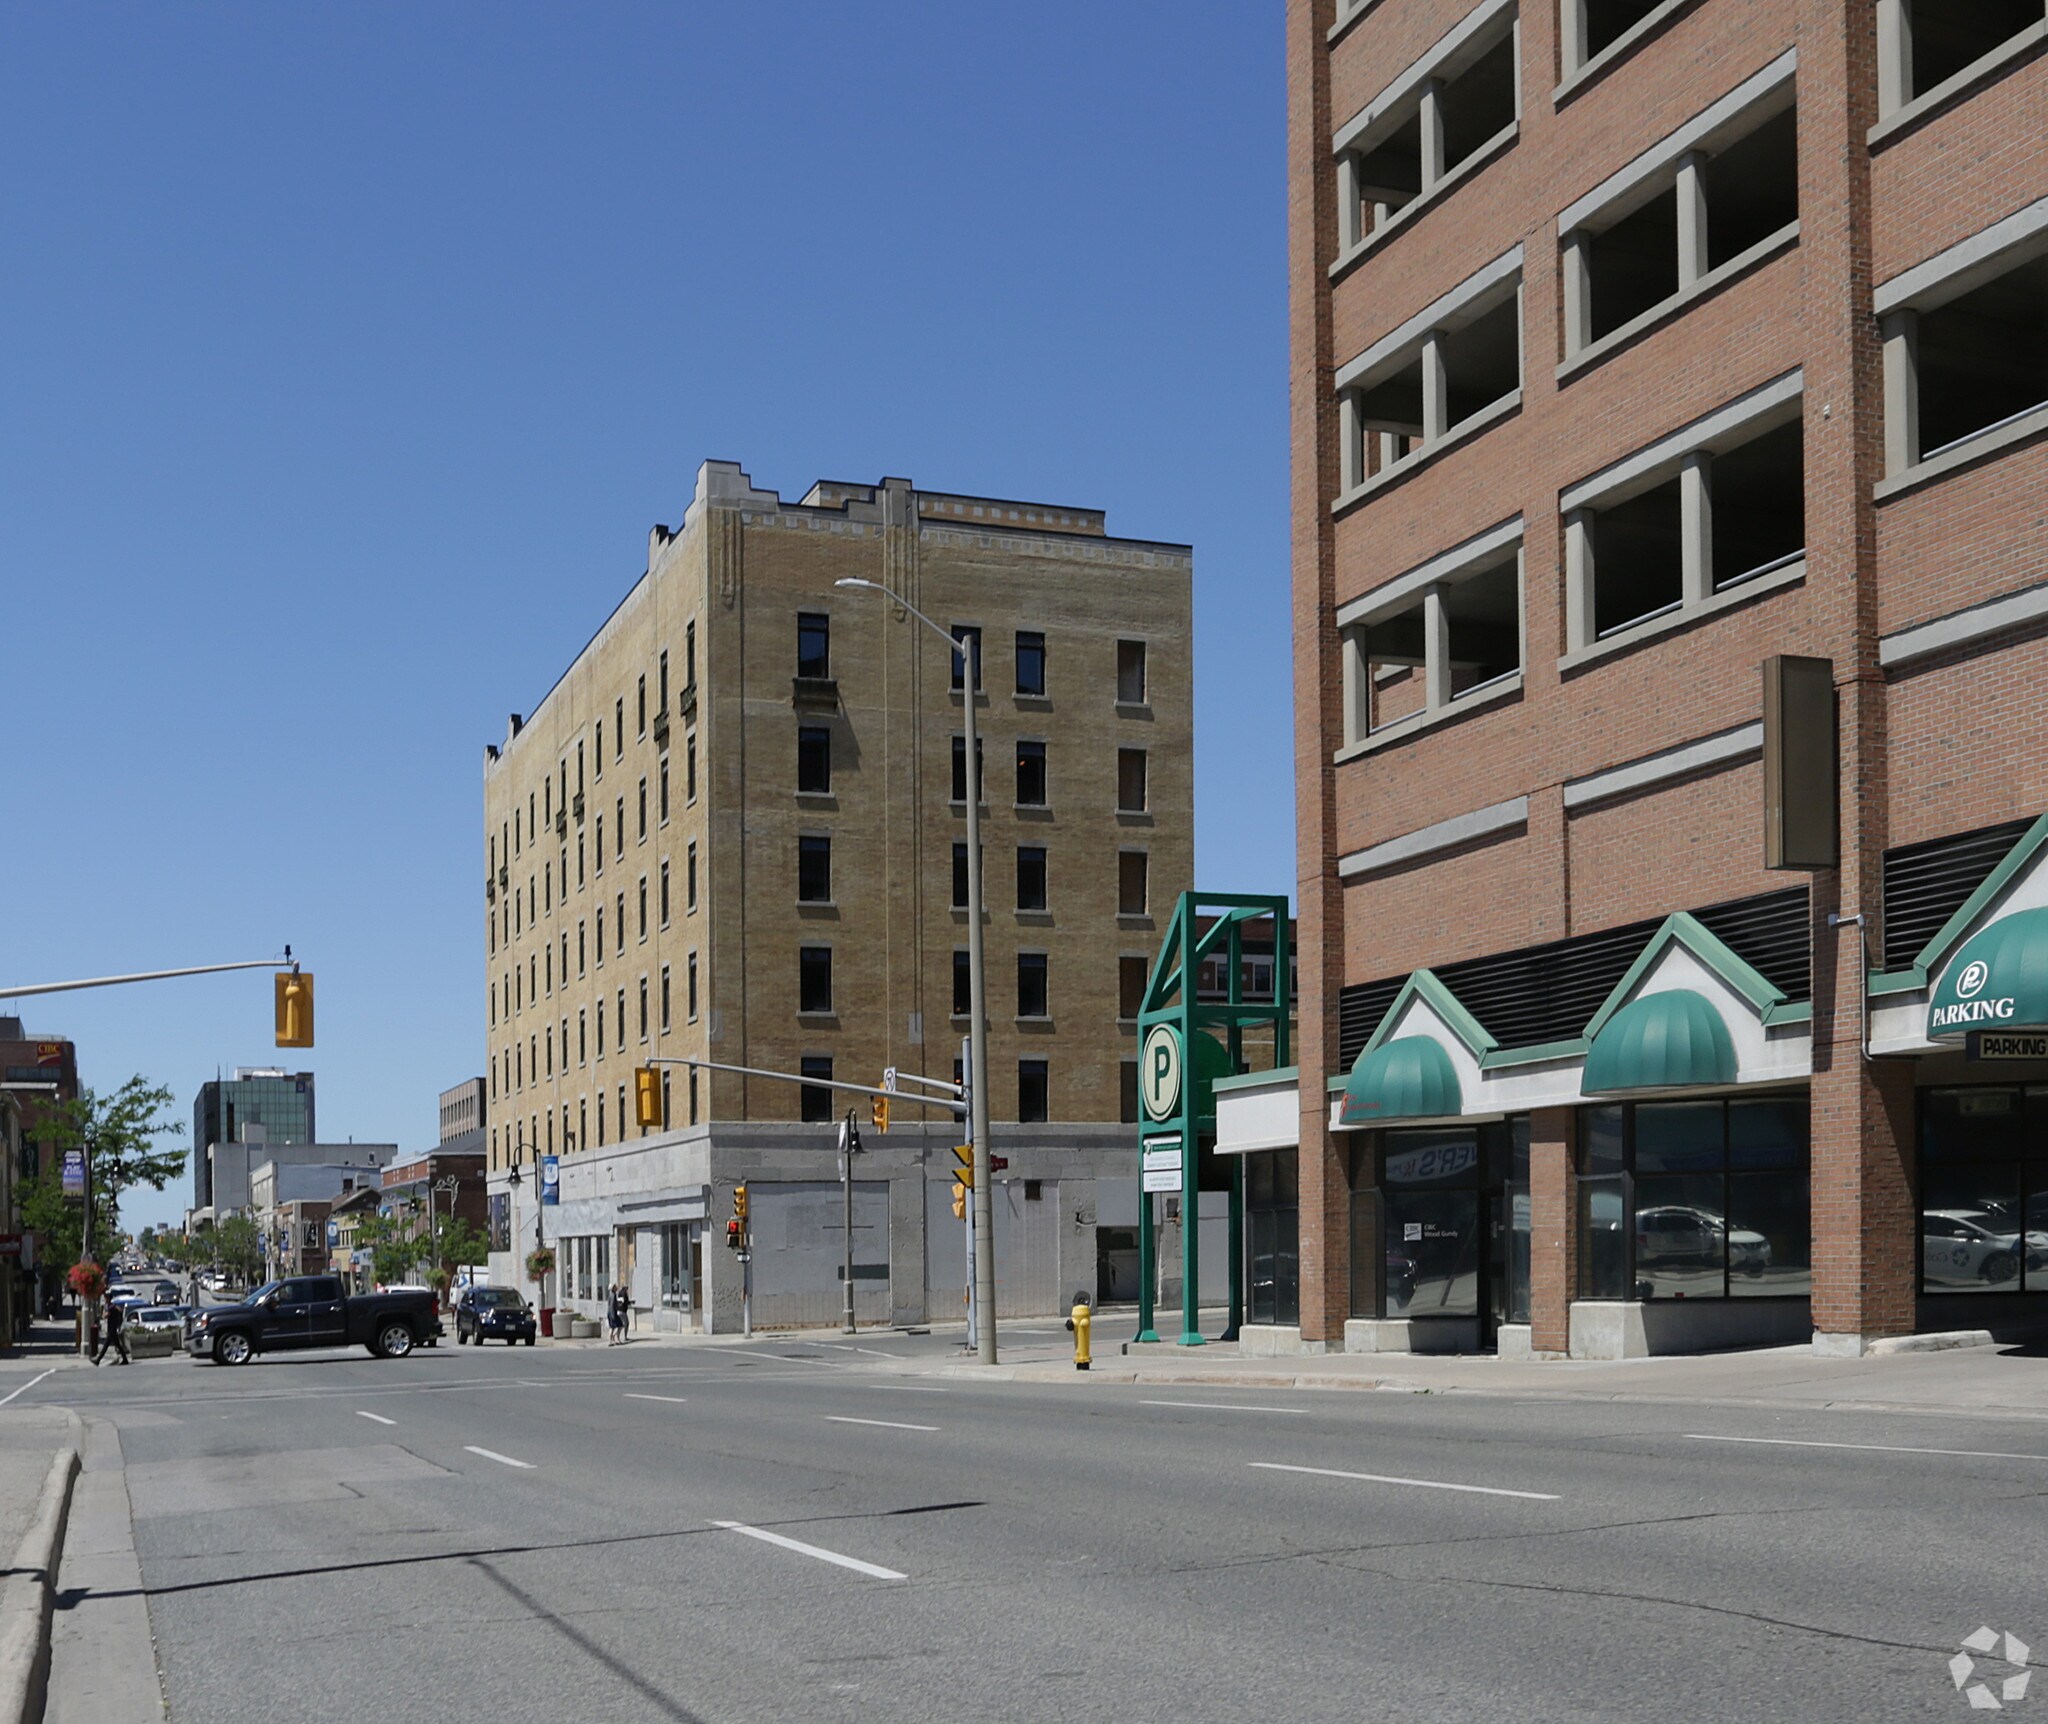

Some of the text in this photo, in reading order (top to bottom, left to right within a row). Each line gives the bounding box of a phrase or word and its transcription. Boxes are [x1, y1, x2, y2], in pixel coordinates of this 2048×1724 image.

[1932, 998, 2015, 1027] PARKING
[38, 1044, 60, 1053] CIBC
[1984, 1038, 2046, 1055] PARKING
[1155, 1045, 1170, 1101] P
